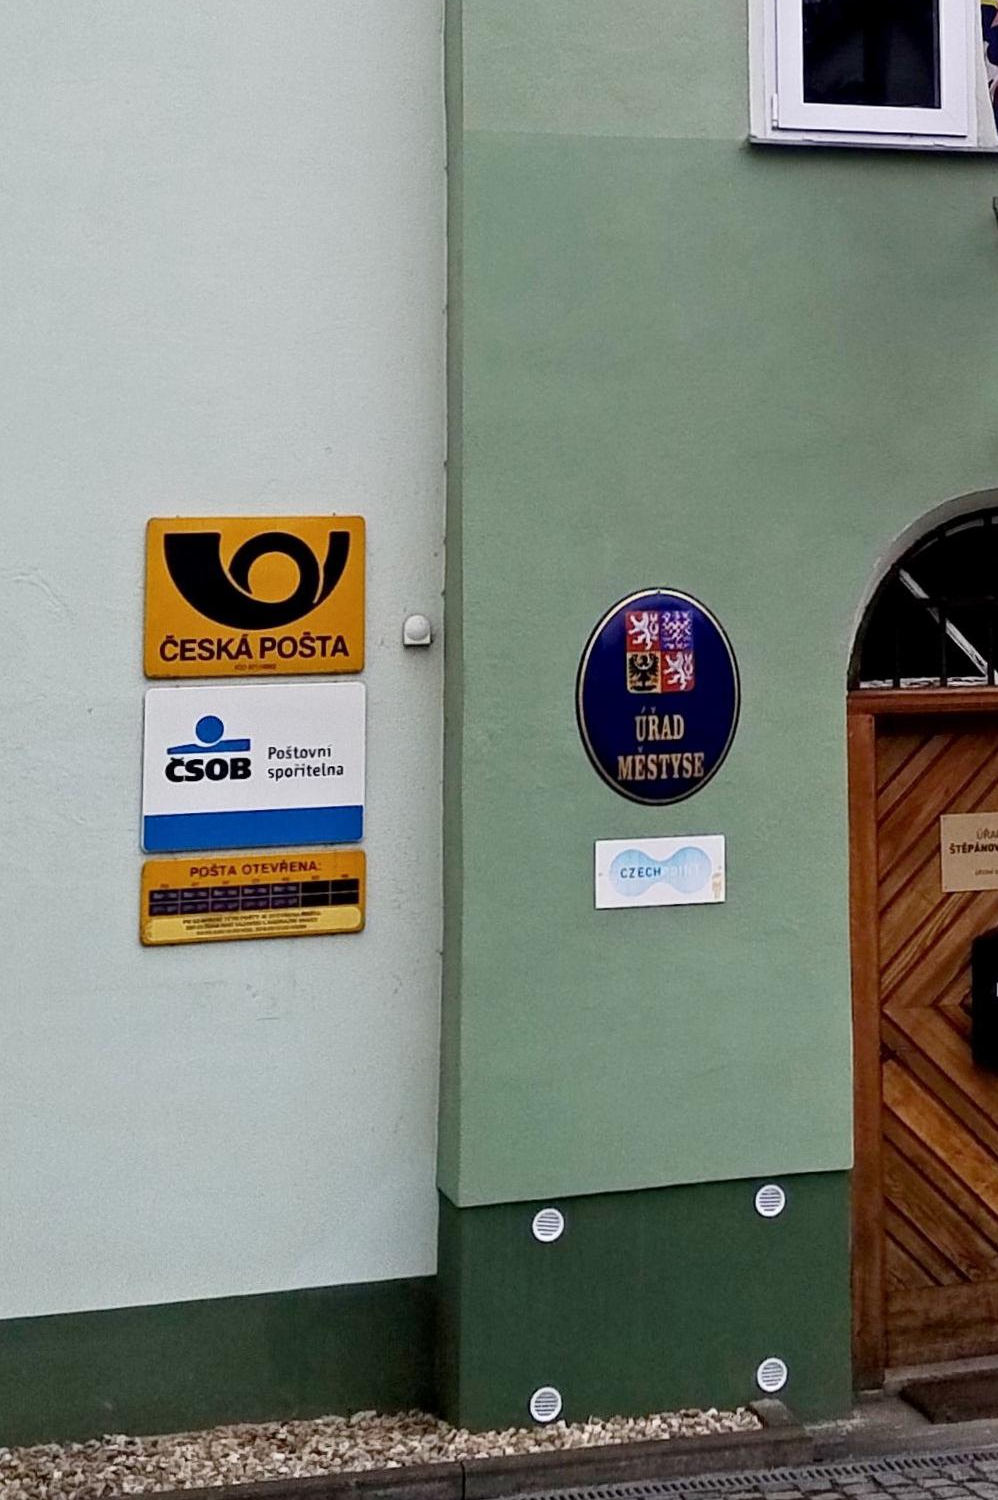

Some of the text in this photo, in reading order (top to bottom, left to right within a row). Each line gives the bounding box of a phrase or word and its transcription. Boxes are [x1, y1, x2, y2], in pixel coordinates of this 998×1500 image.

[159, 631, 350, 662] ČESKÁ POŠTA
[634, 705, 685, 742] ÚŘAD
[268, 744, 332, 760] Poštovní
[165, 757, 252, 783] ČSOB
[268, 763, 344, 782] spořitelna
[617, 746, 705, 781] MĚSTYSE
[190, 863, 237, 877] POŠTA
[620, 866, 661, 879] CZECH
